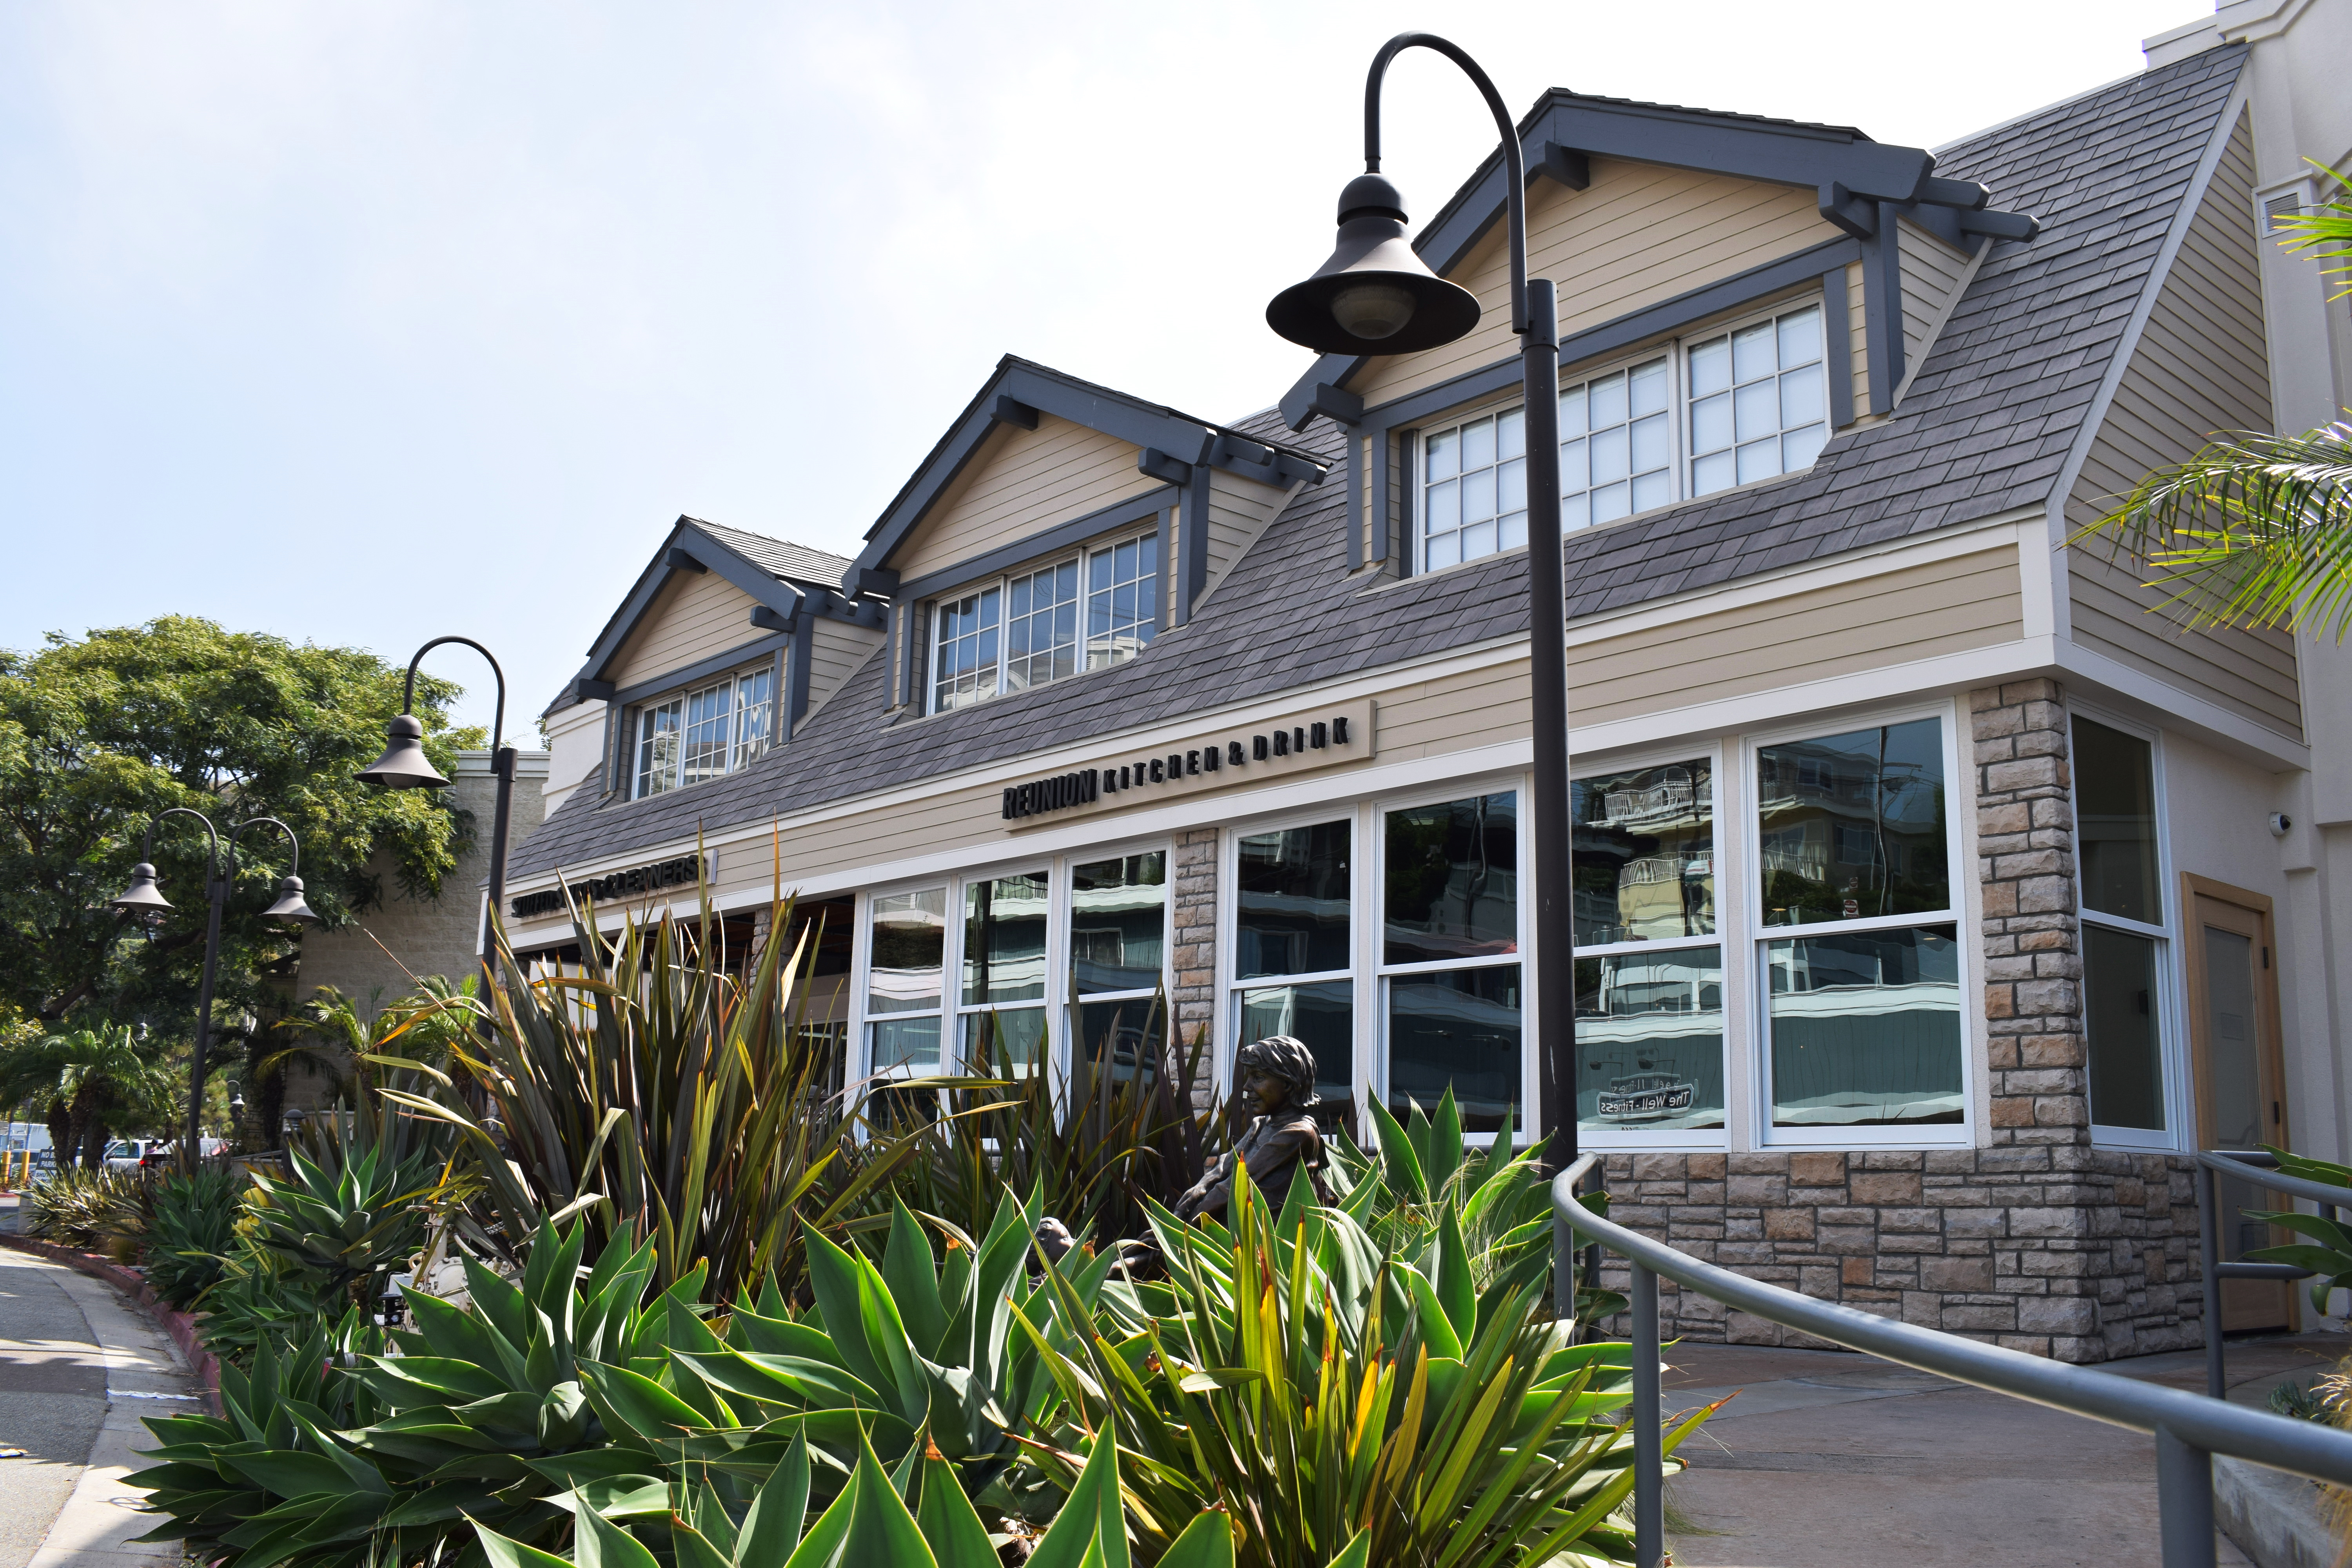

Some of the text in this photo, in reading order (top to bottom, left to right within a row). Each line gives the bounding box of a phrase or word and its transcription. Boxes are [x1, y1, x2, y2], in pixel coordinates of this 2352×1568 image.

[1002, 717, 1348, 820] REUNION KITCHEN & DRINK
[511, 855, 706, 918] STUFFED SIRTS CLEANERS
